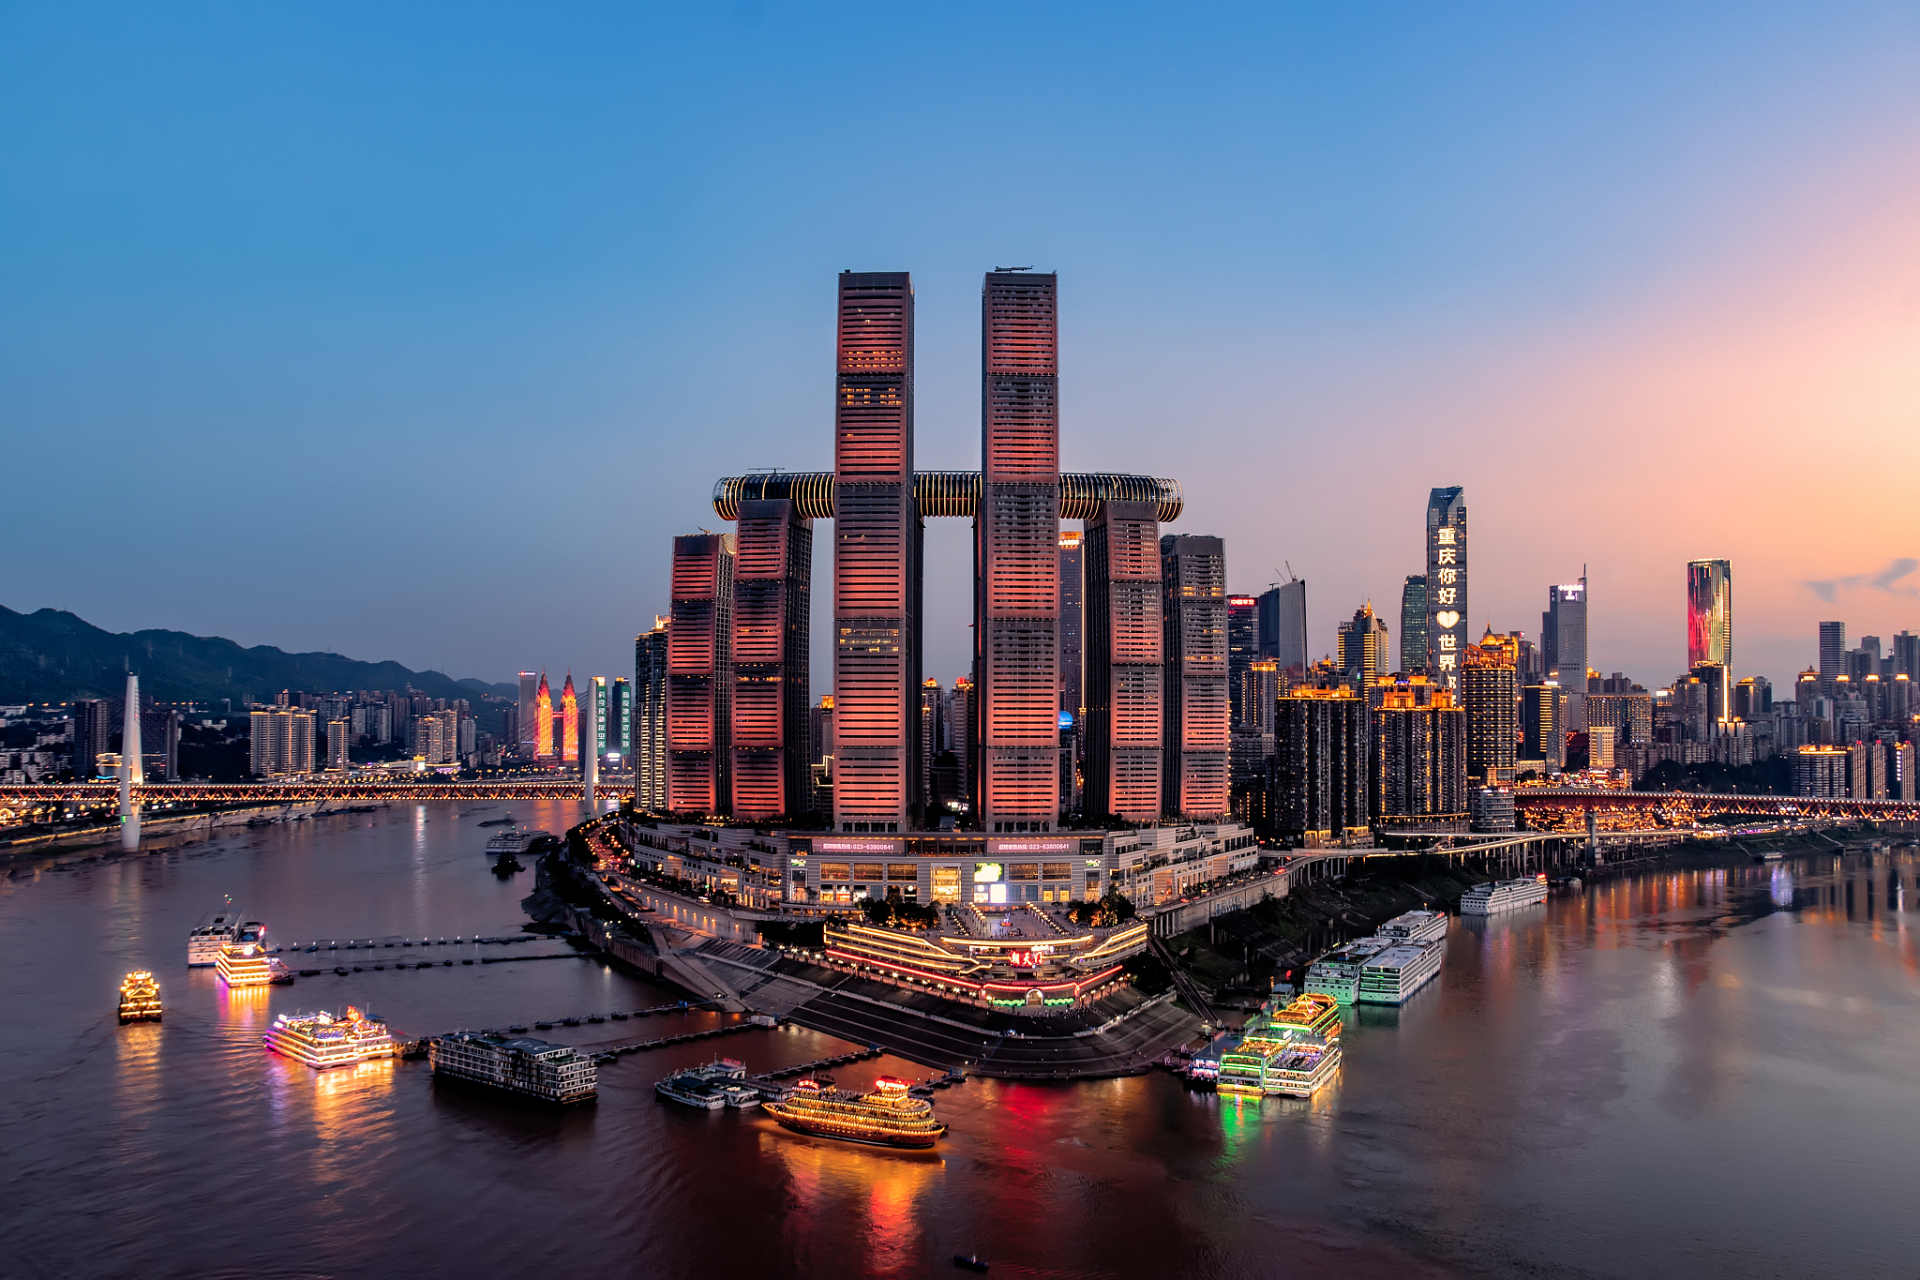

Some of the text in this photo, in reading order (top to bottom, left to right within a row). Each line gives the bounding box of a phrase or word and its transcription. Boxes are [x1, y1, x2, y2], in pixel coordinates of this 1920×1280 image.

[1438, 528, 1456, 604] 重庆你好
[1011, 951, 1043, 966] 朝天门
